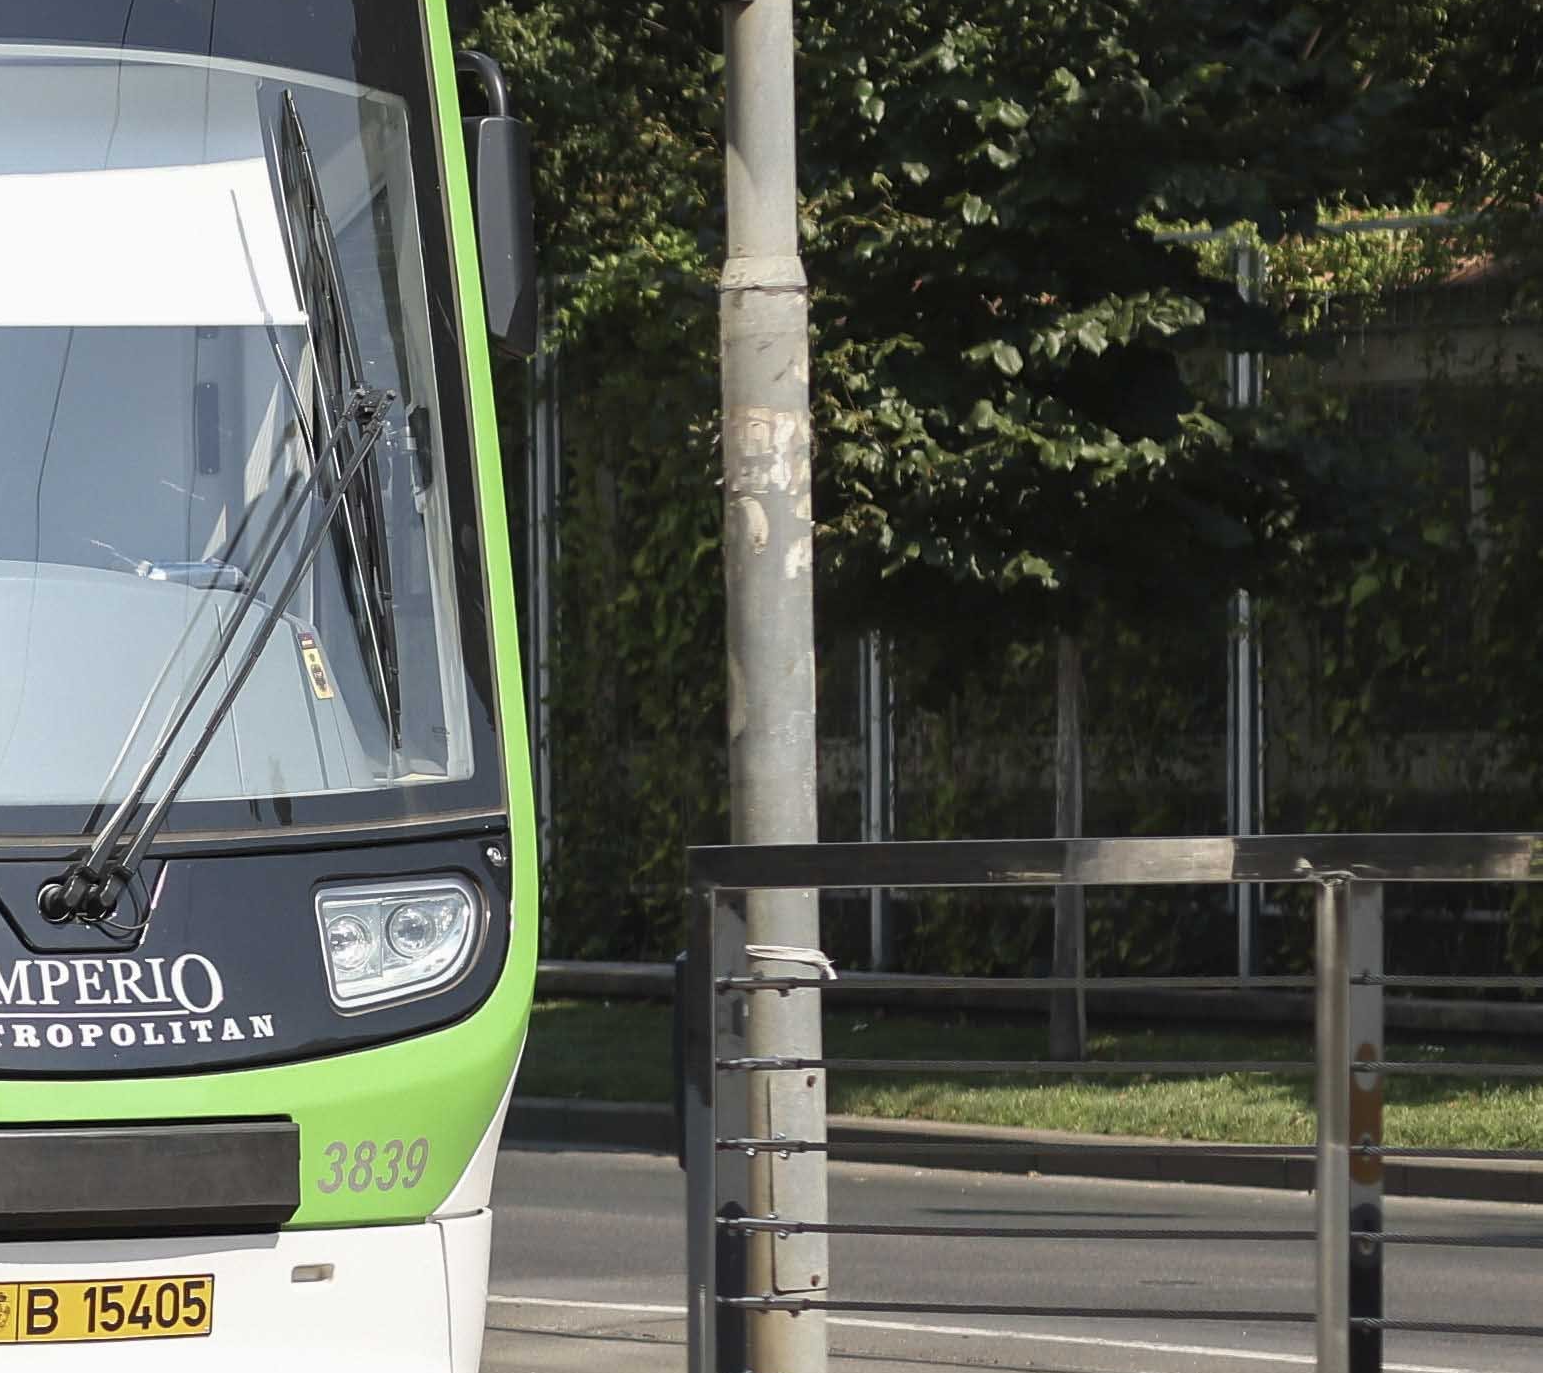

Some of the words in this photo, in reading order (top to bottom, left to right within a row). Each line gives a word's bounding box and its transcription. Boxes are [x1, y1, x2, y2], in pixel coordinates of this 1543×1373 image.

[316, 1137, 431, 1195] 3839
[23, 1288, 61, 1336] B
[81, 1278, 208, 1333] 15405
